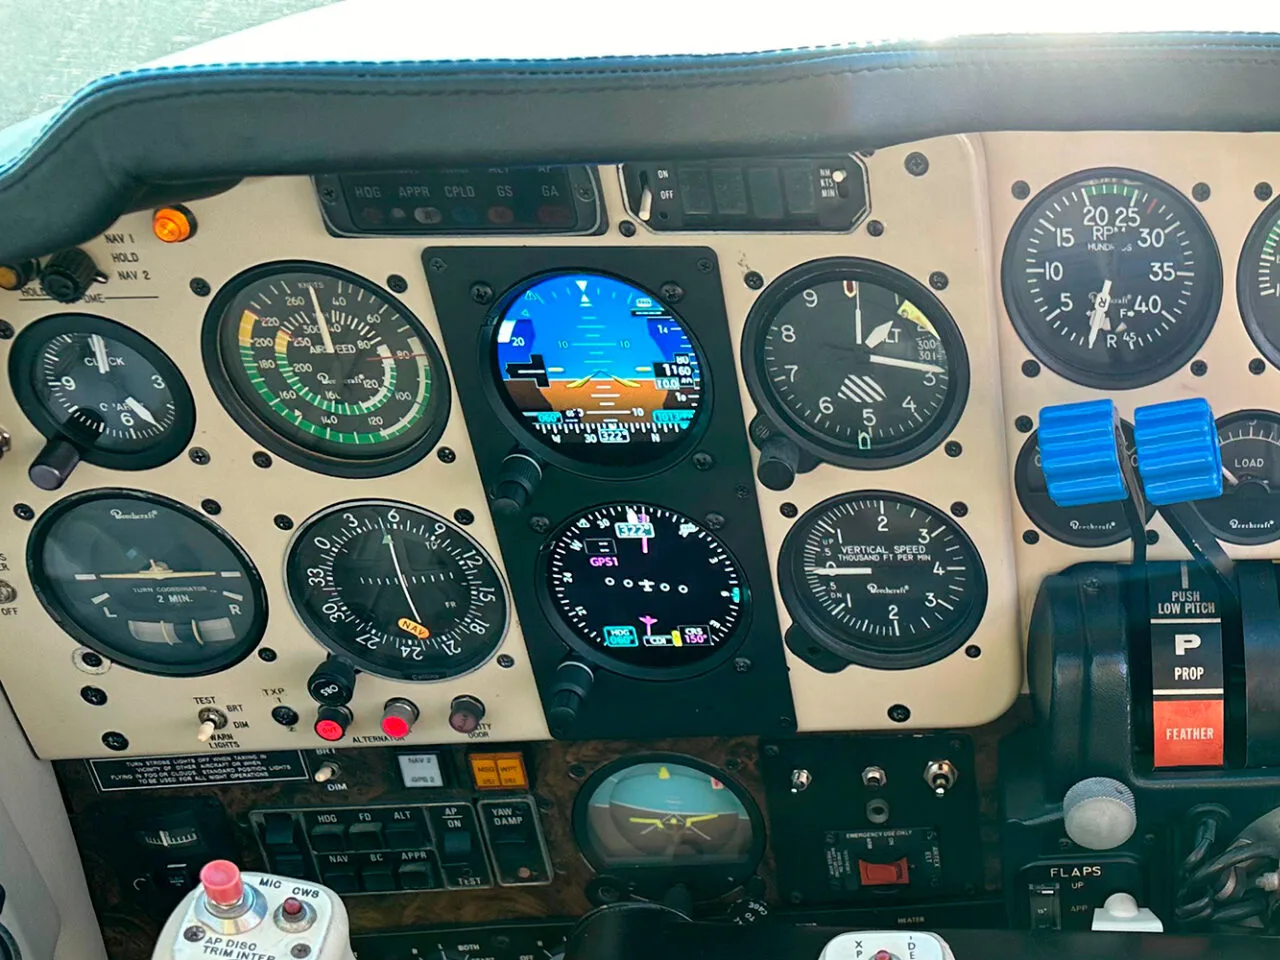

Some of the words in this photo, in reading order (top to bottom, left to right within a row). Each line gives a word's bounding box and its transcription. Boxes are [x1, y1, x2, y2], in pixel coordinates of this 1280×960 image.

[658, 170, 668, 178] ON
[355, 188, 381, 198] HDG
[660, 190, 674, 199] OFF
[1083, 207, 1108, 225] 20
[1115, 208, 1140, 226] 25
[104, 234, 124, 244] NAV
[112, 253, 139, 262] HOLD
[118, 271, 138, 280] NAV
[143, 271, 150, 280] 2
[1149, 263, 1175, 281] 35
[1134, 296, 1161, 313] 40
[781, 325, 795, 342] 8
[1235, 459, 1264, 467] LOAD
[841, 546, 888, 554] VERTICAL
[589, 557, 618, 566] GPS1
[157, 595, 164, 603] 2
[169, 595, 193, 603] MIN.
[1172, 591, 1200, 601] PUSH
[1158, 603, 1180, 614] LOW
[1185, 603, 1215, 614] PITCH
[401, 621, 425, 635] NAV
[1175, 634, 1201, 655] P
[1174, 667, 1204, 680] PROP
[1166, 728, 1214, 740] FEATHER
[328, 783, 347, 791] DIM
[394, 811, 410, 819] ALT
[445, 807, 457, 815] AP
[492, 808, 512, 816] YAW
[318, 814, 337, 823] HDG
[494, 816, 522, 825] DAMP
[448, 820, 461, 828] ON
[329, 855, 348, 863] NAV
[401, 851, 426, 860] APPR
[1050, 866, 1101, 878] FLAPS
[259, 877, 281, 889] MIC
[205, 936, 223, 945] AP
[226, 939, 257, 950] DISC
[203, 946, 233, 959] TRIM
